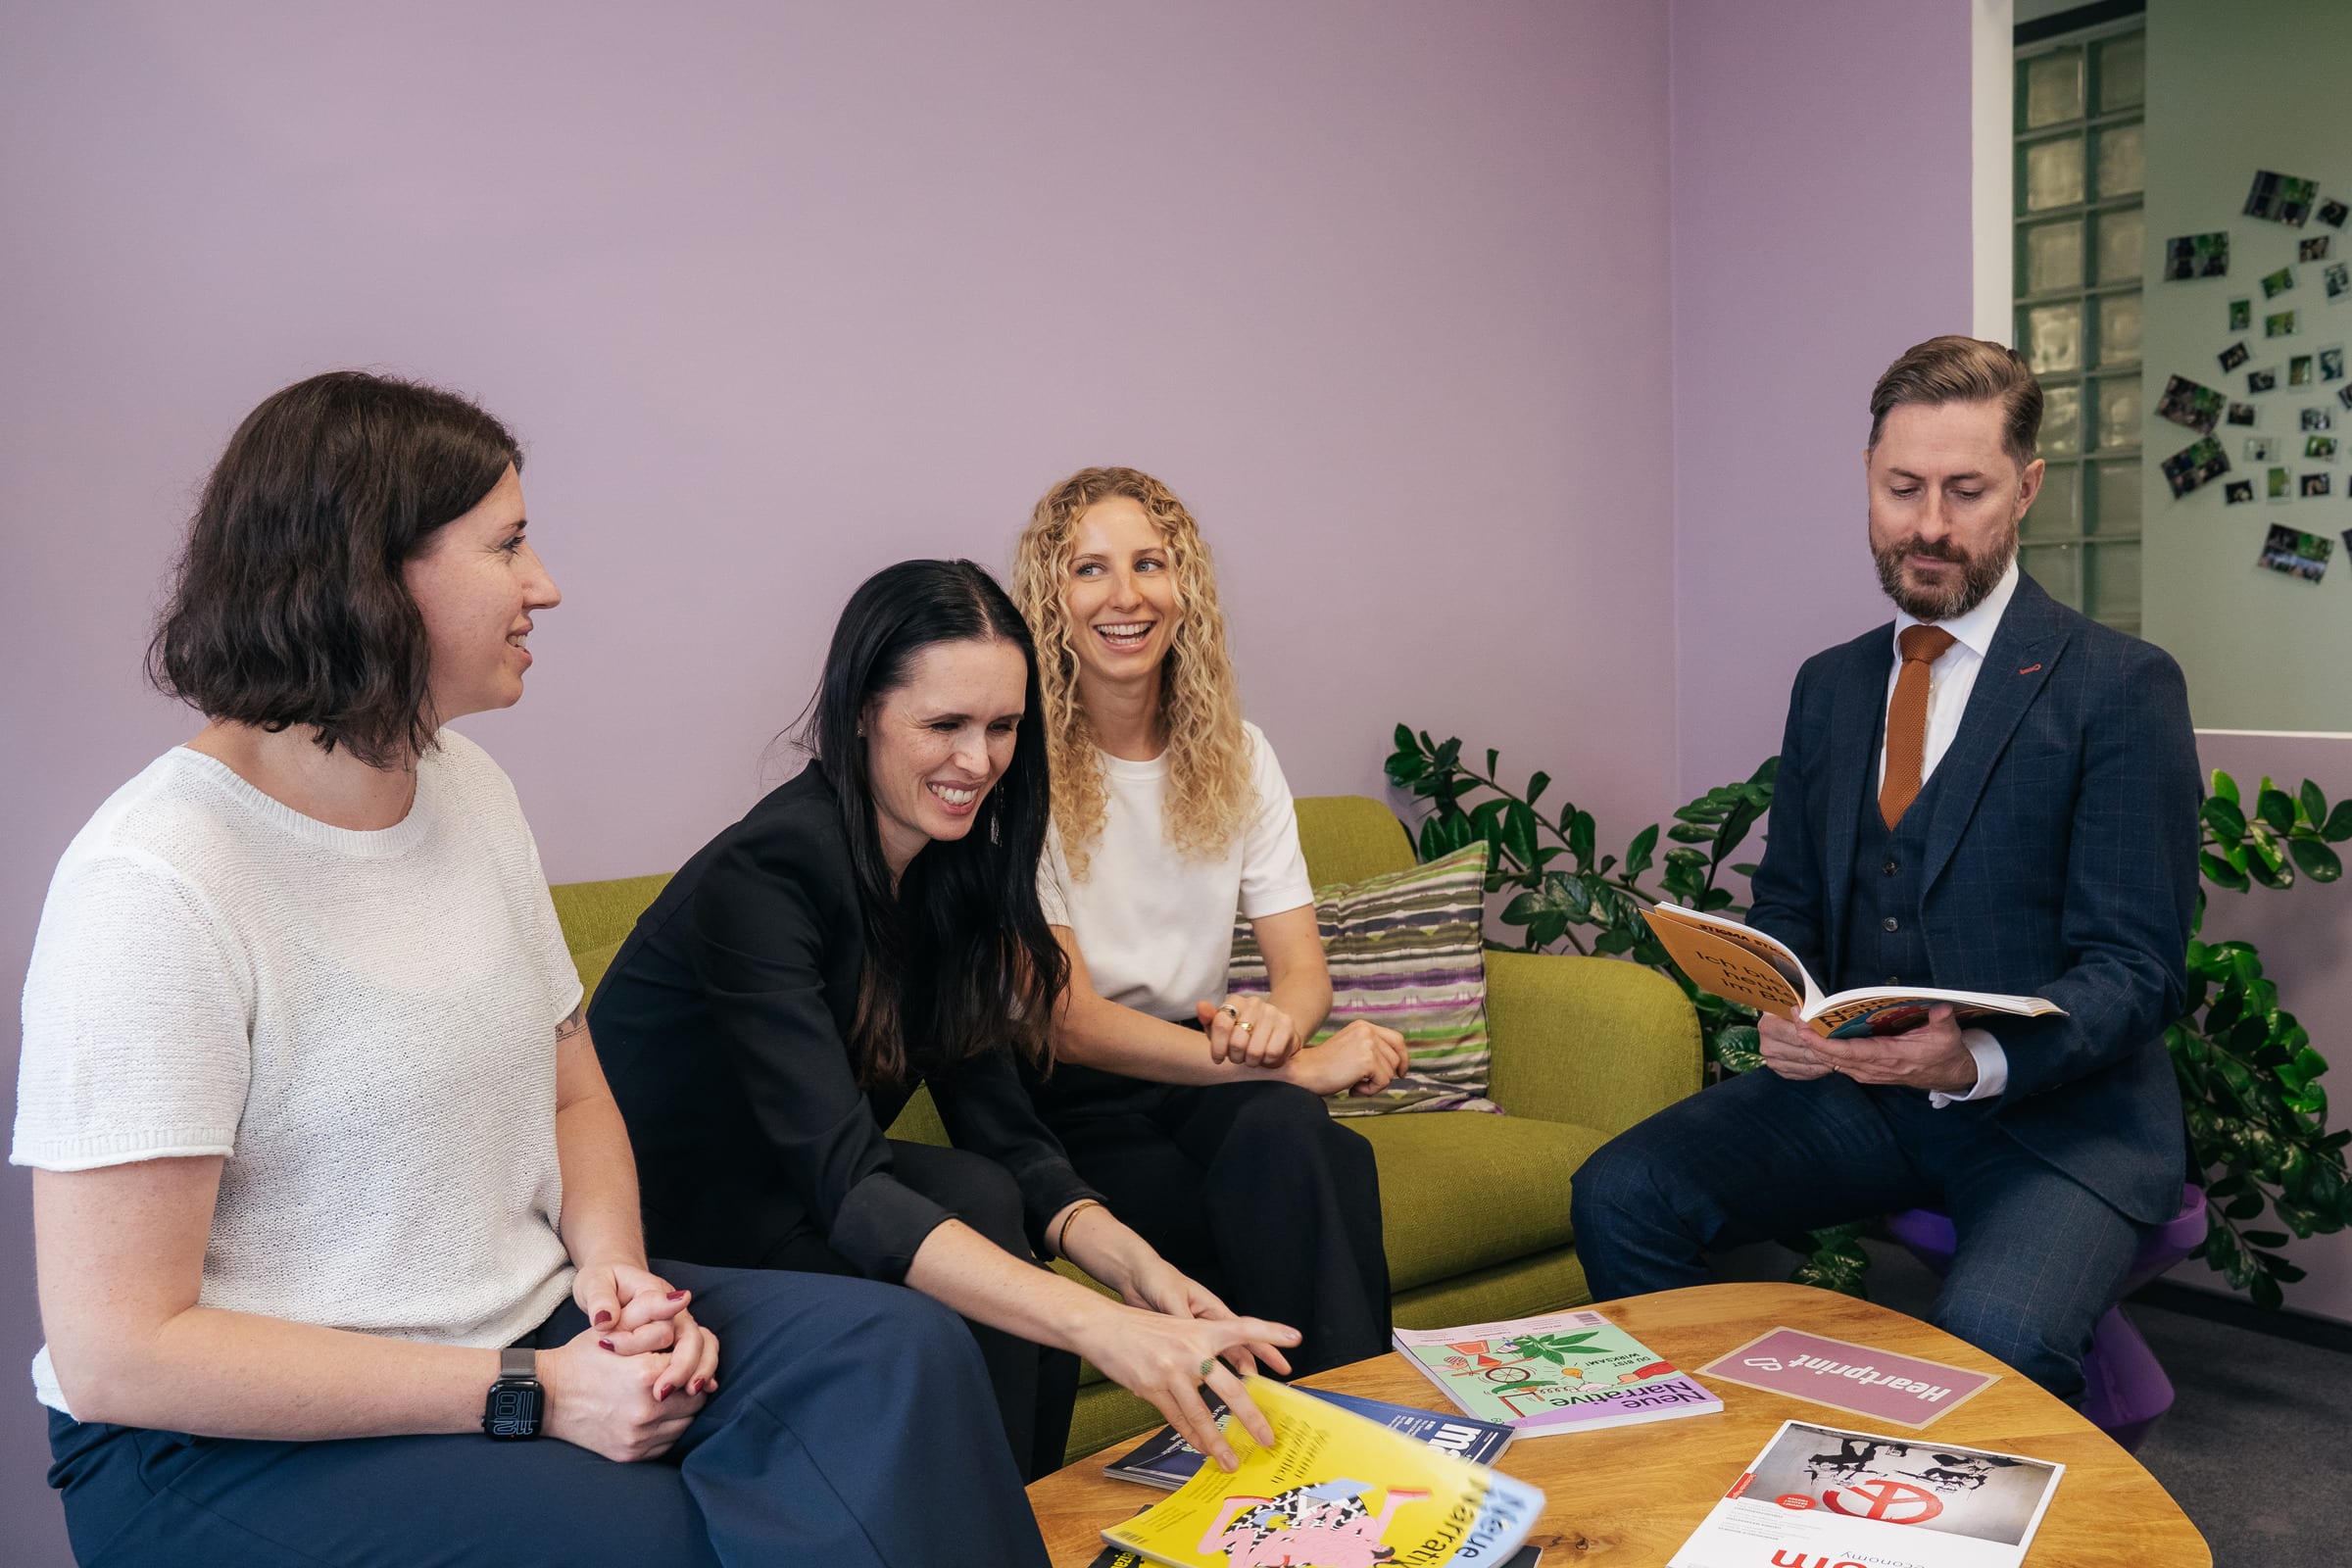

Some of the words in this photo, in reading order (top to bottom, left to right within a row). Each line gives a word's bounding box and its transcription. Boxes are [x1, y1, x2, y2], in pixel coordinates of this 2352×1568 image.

[1696, 951, 1737, 970] Ich
[1721, 978, 1753, 995] im
[1759, 990, 1796, 1007] Be
[1585, 1352, 1642, 1367] WIRKSAM!
[1612, 1358, 1635, 1368] BIST
[1636, 1355, 1651, 1364] DU
[1788, 1353, 1952, 1402] Heartprint
[1550, 1381, 1694, 1407] Narrative
[1621, 1391, 1706, 1409] Neue
